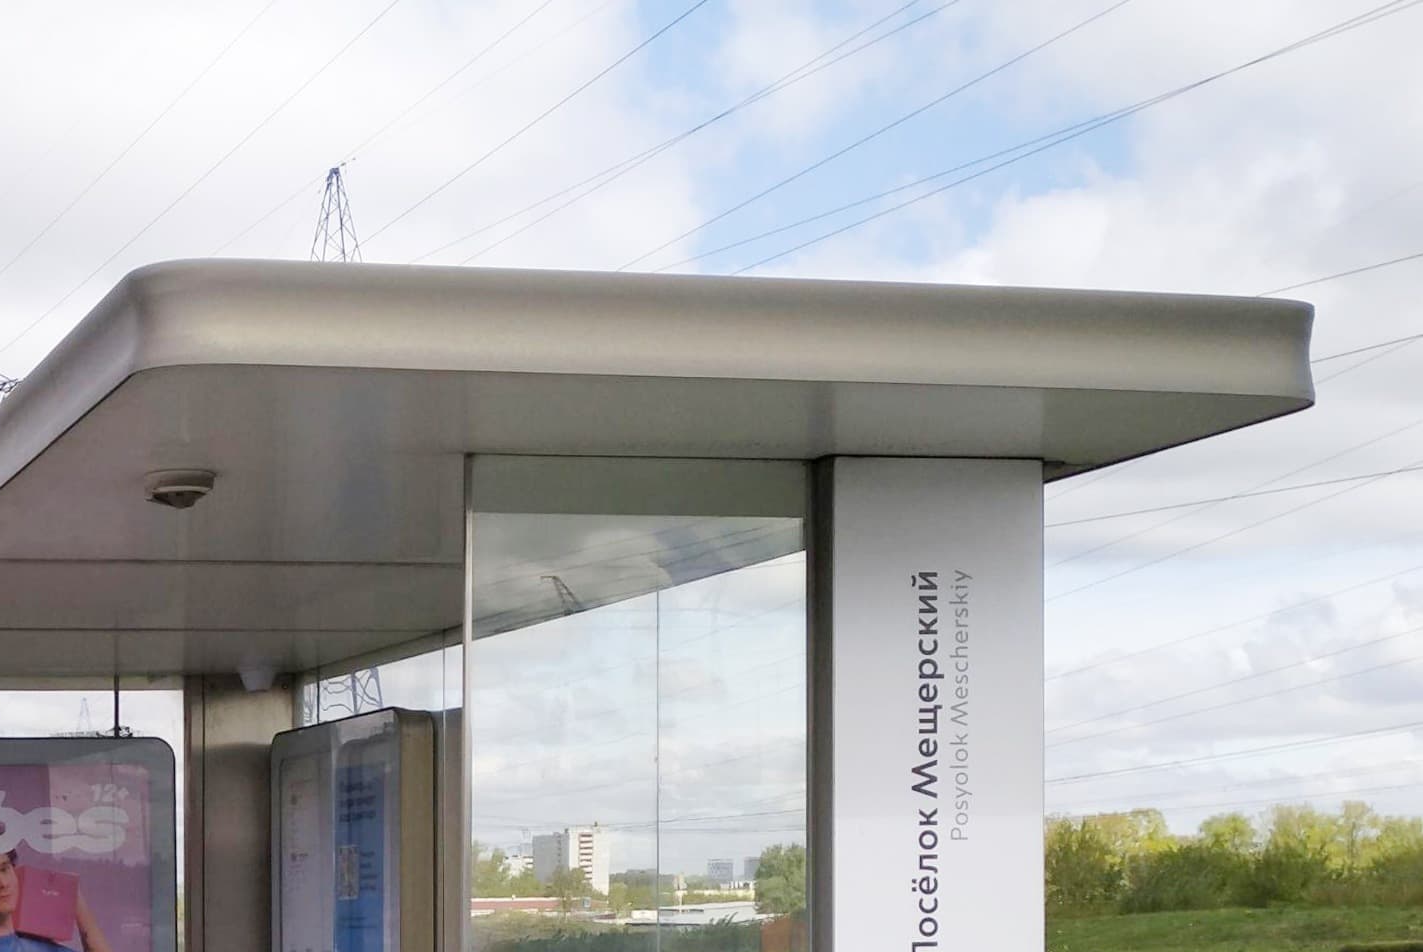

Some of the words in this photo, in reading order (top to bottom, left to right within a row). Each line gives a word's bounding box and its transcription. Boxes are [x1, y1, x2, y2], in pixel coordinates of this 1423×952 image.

[911, 570, 944, 799] Мещерский
[949, 568, 973, 726] Mescherskiy
[949, 731, 973, 841] Posyolok
